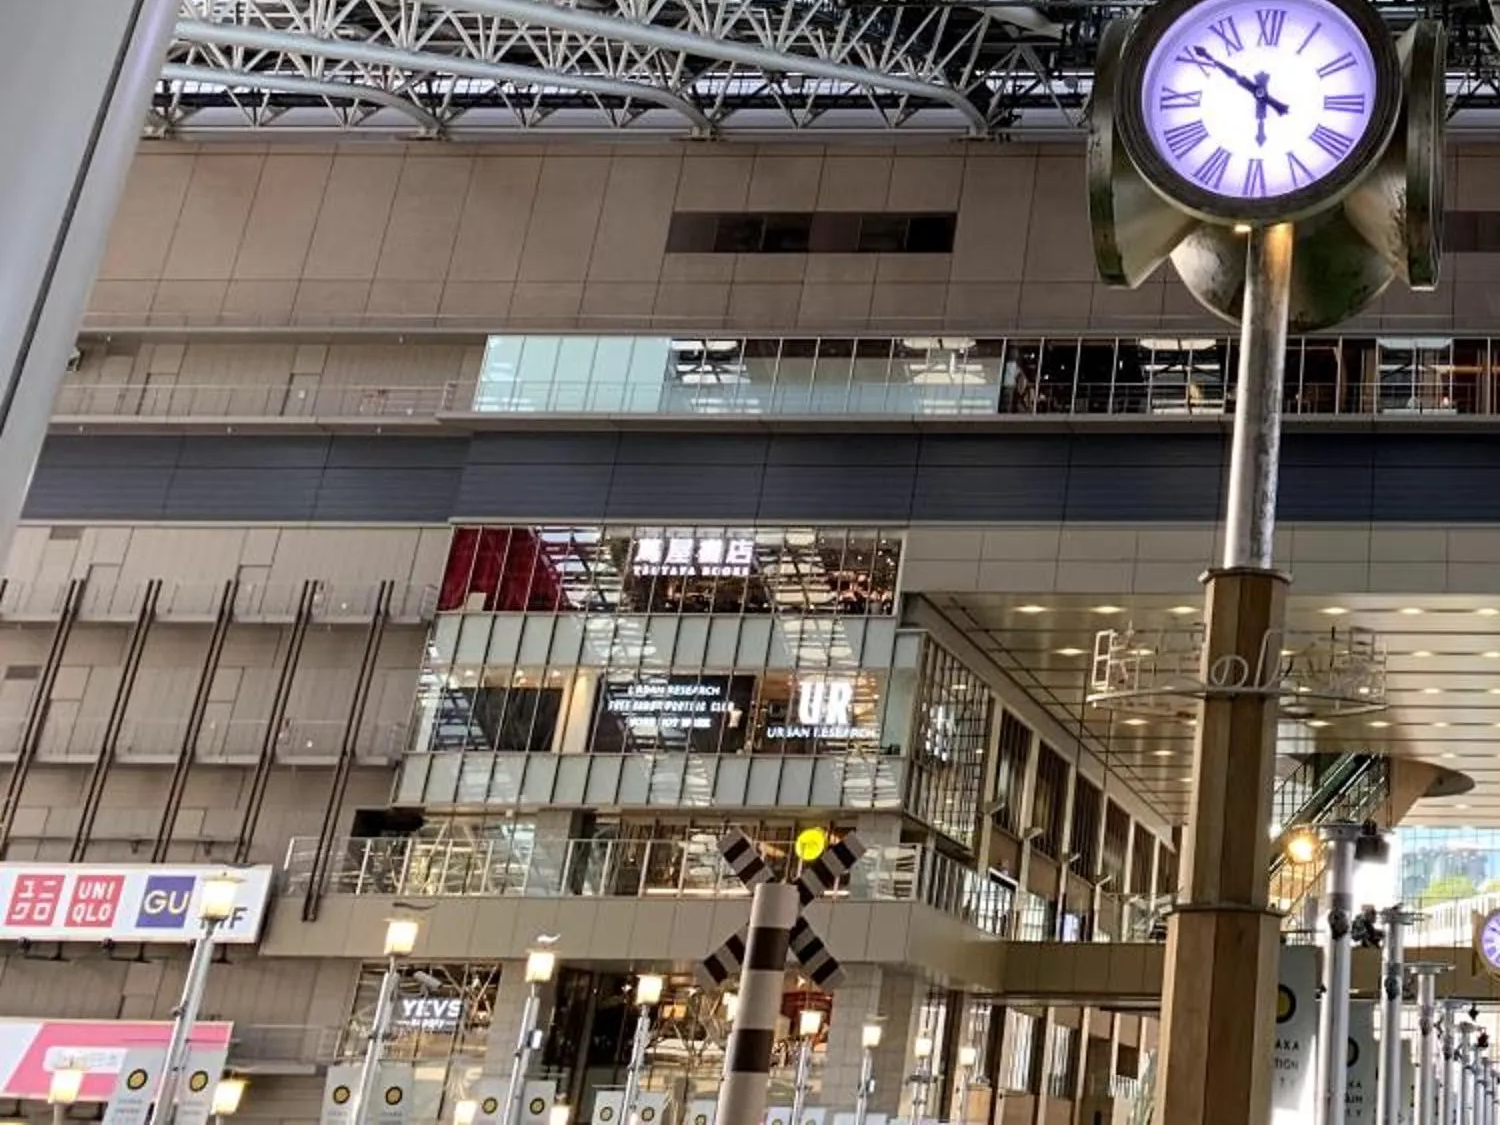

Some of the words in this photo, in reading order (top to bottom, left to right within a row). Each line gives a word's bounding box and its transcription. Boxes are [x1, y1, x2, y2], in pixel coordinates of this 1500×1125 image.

[1208, 15, 1244, 57] XI
[1255, 9, 1287, 47] XII
[1175, 45, 1216, 79] X
[1316, 51, 1358, 79] II
[1160, 85, 1202, 111] IX
[1323, 93, 1365, 114] III
[1163, 120, 1210, 160] VIII
[1192, 146, 1232, 190] VII
[1242, 158, 1267, 197] VI
[1286, 151, 1316, 188] V
[78, 881, 115, 899] UNI
[143, 889, 190, 915] GU
[71, 903, 112, 922] QLO
